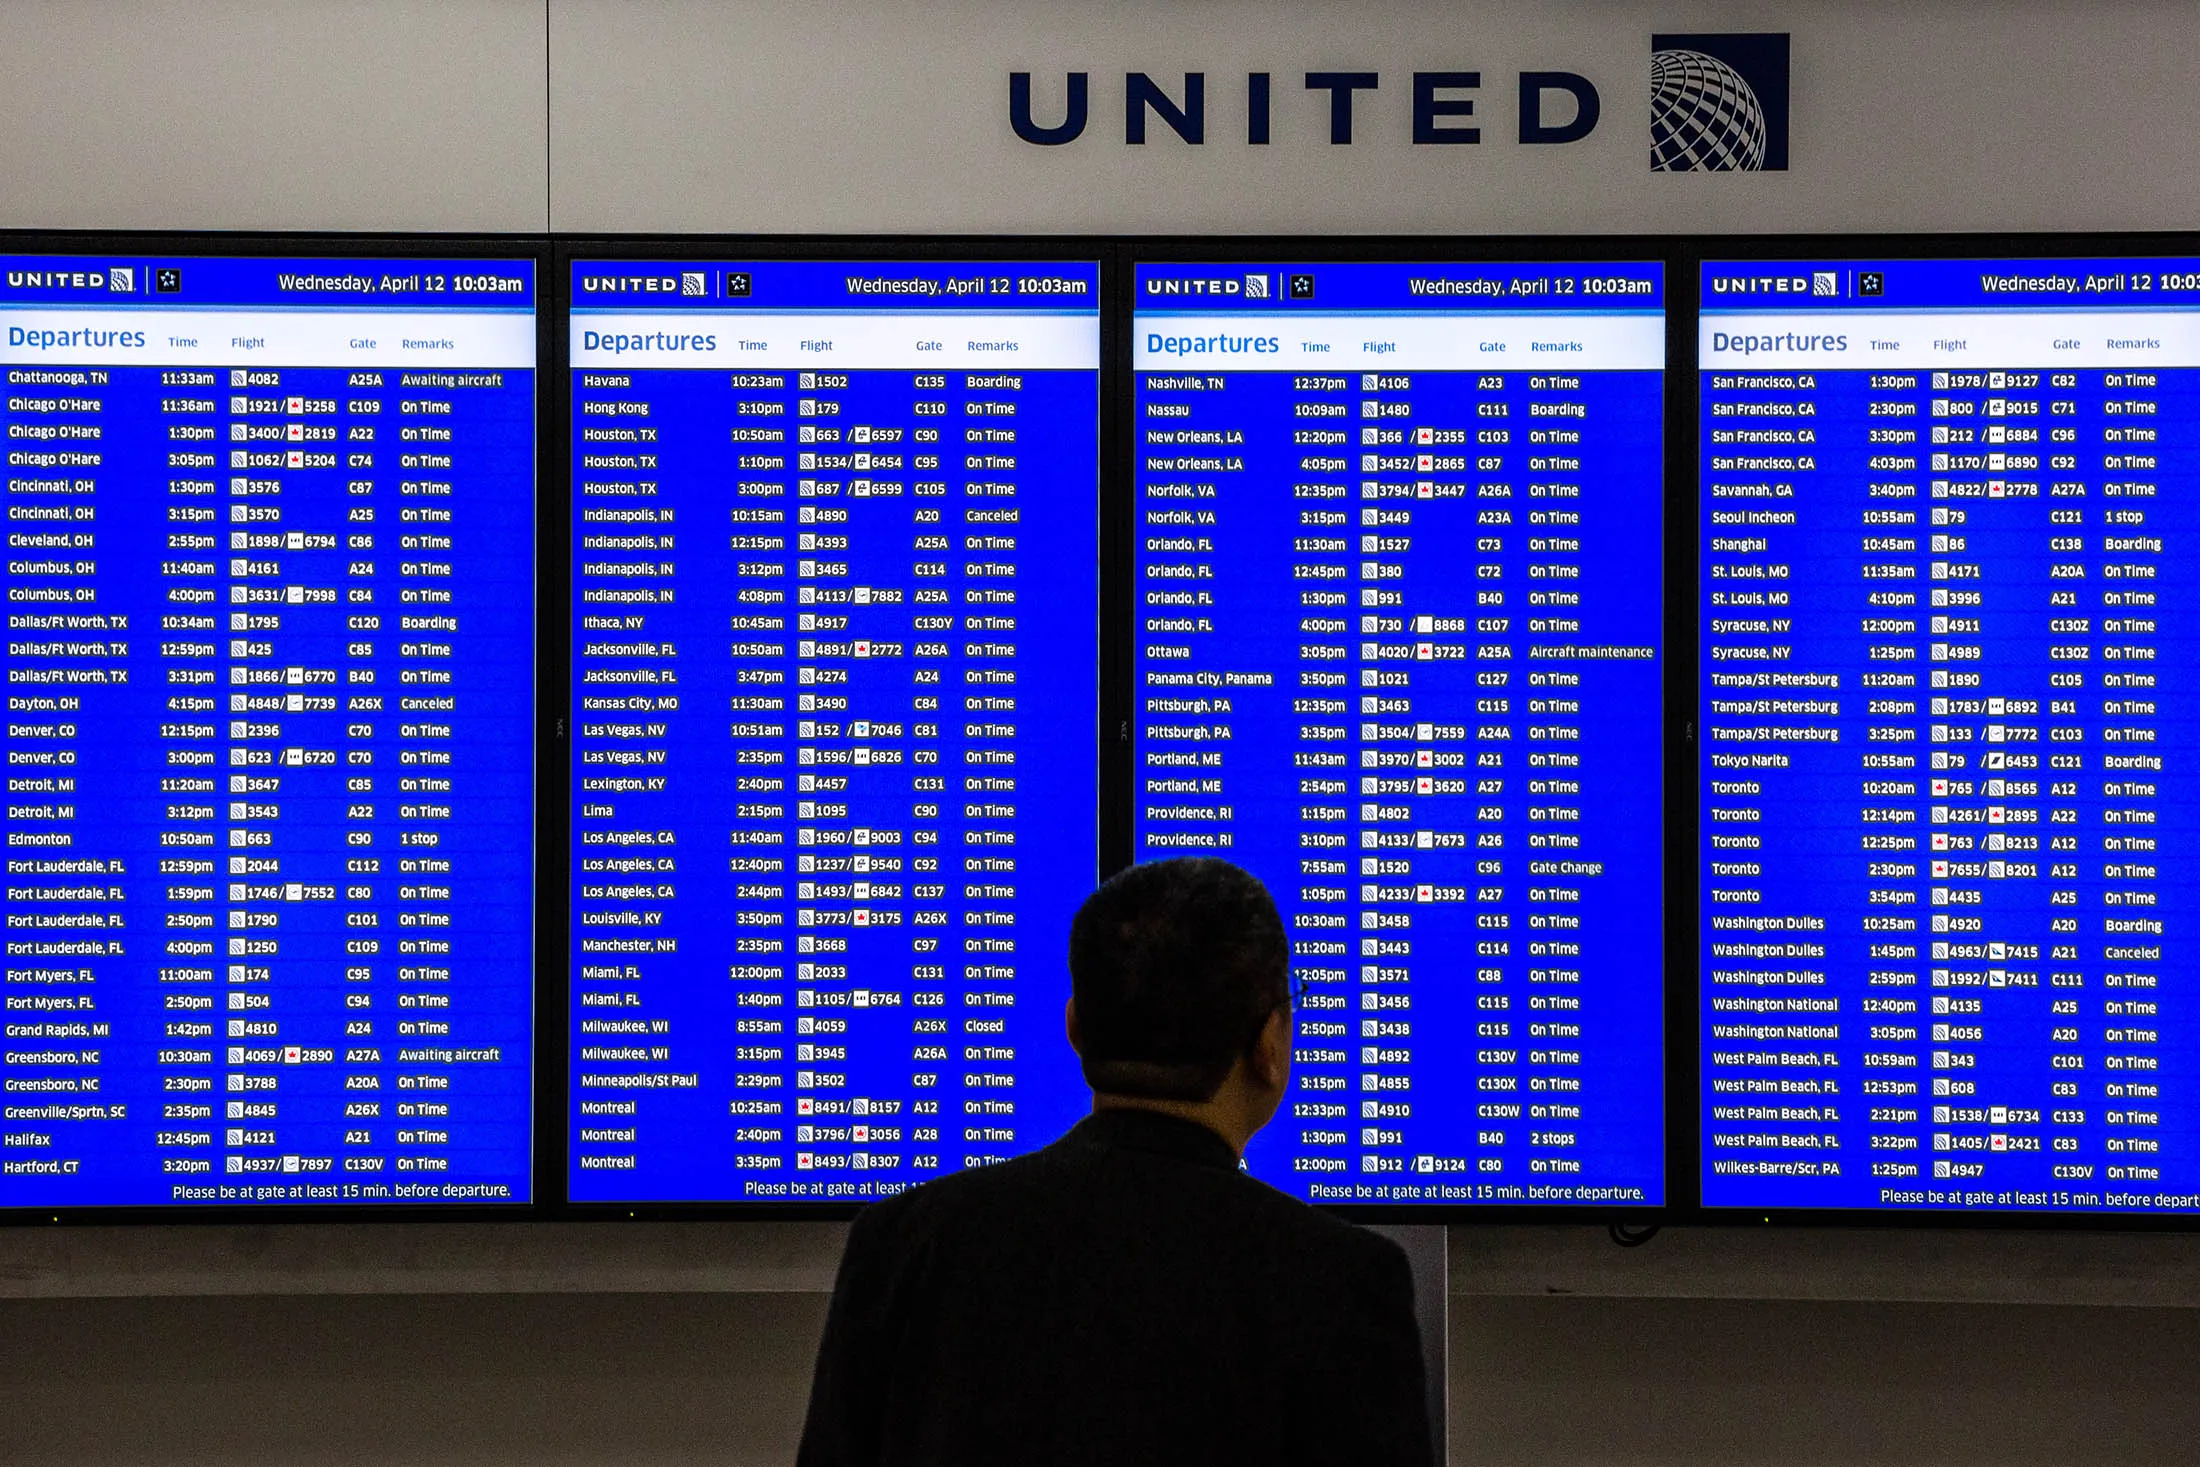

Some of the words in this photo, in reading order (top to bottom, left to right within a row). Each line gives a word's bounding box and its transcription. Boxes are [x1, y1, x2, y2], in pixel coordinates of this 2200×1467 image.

[1009, 71, 1601, 145] UNITED
[8, 272, 104, 287] UNITED
[278, 274, 376, 293] Wednesday,
[380, 275, 419, 293] April
[425, 275, 445, 292] 12
[453, 275, 523, 292] 10:03am
[583, 277, 677, 292] UNITED
[846, 277, 942, 296] Wednesday,
[946, 277, 984, 296] April
[990, 278, 1010, 293] 12
[1018, 278, 1087, 293] 10:03am
[1147, 280, 1240, 294] UNITED
[1410, 278, 1506, 297] Wednesday,
[1510, 278, 1548, 296] April
[1554, 278, 1574, 294] 12
[1583, 278, 1652, 294] 10:03am
[1713, 278, 1807, 293] UNITED
[1982, 275, 2080, 294] Wednesday,
[2084, 274, 2125, 293] April
[2131, 274, 2151, 290] 12
[9, 326, 146, 351] Departures
[168, 337, 198, 348] Time
[231, 337, 264, 349] Flight
[349, 338, 377, 349] Gate
[402, 339, 454, 349] Remarks
[584, 330, 717, 355] Departures
[738, 339, 768, 351] Time
[800, 339, 833, 353] Flight
[916, 341, 943, 351] Gate
[967, 340, 1019, 352] Remarks
[1147, 333, 1280, 357] Departures
[1713, 332, 1848, 356] Departures
[1870, 340, 1900, 351] Time
[1933, 339, 1967, 352] Flight
[2053, 339, 2081, 349] Gate
[2107, 338, 2160, 349] Remarks
[1301, 341, 1331, 353] Time
[1363, 341, 1396, 355] Flight
[1479, 341, 1506, 353] Gate
[1531, 340, 1583, 352] Remarks
[8, 370, 88, 386] Chattanooga,
[90, 371, 108, 384] TN
[162, 372, 215, 385] 11:33am
[247, 372, 279, 385] 4082
[348, 373, 383, 386] A25A
[401, 373, 456, 388] Awaiting
[457, 373, 502, 387] aircraft
[584, 375, 630, 387] Havana
[732, 375, 784, 388] 10:23am
[816, 375, 848, 388] 1502
[914, 376, 945, 388] C135
[967, 375, 1021, 390] Boarding
[1147, 404, 1190, 417] Nassau
[1295, 404, 1346, 417] 10:09am
[1379, 404, 1410, 417] 1480
[1478, 404, 1508, 416] C111
[1530, 402, 1585, 418] Boarding
[1712, 537, 1766, 553] Shanghai
[1863, 538, 1916, 551] 10:45am
[1948, 537, 1966, 551] 86
[2050, 537, 2082, 551] C138
[2105, 536, 2162, 552] Boarding
[9, 615, 65, 629] Dallas/Ft
[66, 615, 108, 630] Worth,
[110, 616, 128, 628] TX
[162, 615, 215, 629] 10:34am
[248, 616, 279, 629] 1795
[348, 616, 380, 629] C120
[401, 615, 457, 631] Boarding
[584, 616, 623, 630] Ithaca,
[625, 616, 644, 629] NY
[732, 617, 784, 629] 10:45am
[815, 617, 848, 629] 4917
[914, 617, 953, 629] C130Y
[966, 617, 983, 629] On
[984, 616, 1015, 629] Time
[1147, 672, 1194, 685] Panama
[1196, 671, 1223, 687] City,
[1225, 672, 1273, 685] Panama
[1301, 672, 1346, 687] 3:50pm
[1378, 672, 1409, 685] 1021
[1477, 672, 1508, 685] C127
[1529, 673, 1546, 686] On
[1548, 672, 1579, 686] Time
[8, 832, 71, 846] Edmonton
[161, 832, 214, 845] 10:50am
[247, 832, 272, 845] 663
[347, 832, 372, 845] C90
[401, 832, 409, 845] 1
[411, 832, 438, 847] stop
[1301, 861, 1346, 873] 7:55am
[1378, 861, 1410, 874] 1520
[1477, 861, 1501, 874] C96
[1530, 861, 1558, 874] Gate
[1560, 861, 1602, 876] Change
[1712, 916, 1784, 931] Washington
[1786, 916, 1825, 930] Dulles
[1863, 917, 1916, 930] 10:25am
[1948, 918, 1982, 931] 4920
[2051, 919, 2077, 932] A20
[2105, 918, 2163, 934] Boarding
[582, 1019, 649, 1034] Milwaukee,
[651, 1020, 669, 1033] WI
[737, 1020, 782, 1033] 8:55am
[814, 1020, 846, 1033] 4059
[914, 1020, 946, 1032] A26X
[965, 1019, 1004, 1033] Closed
[1302, 1131, 1346, 1145] 1:30pm
[1379, 1131, 1403, 1144] 991
[1479, 1132, 1504, 1145] B40
[1531, 1132, 1540, 1145] 2
[1542, 1132, 1575, 1147] stops
[1714, 1160, 1820, 1176] Wilkes-Barre/Scr,
[1822, 1162, 1840, 1175] PA
[1872, 1163, 1918, 1177] 1:25pm
[1951, 1164, 1984, 1177] 4947
[2053, 1165, 2093, 1178] C130V
[2107, 1166, 2125, 1179] On
[2126, 1166, 2159, 1179] Time
[173, 1185, 216, 1199] Please
[219, 1185, 237, 1199] be
[239, 1185, 253, 1199] at
[256, 1185, 286, 1200] gate
[289, 1185, 303, 1198] at
[306, 1184, 338, 1198] least
[342, 1184, 359, 1198] 15
[363, 1183, 392, 1197] min.
[395, 1183, 439, 1197] before
[442, 1183, 511, 1199] departure.
[745, 1181, 787, 1195] Please
[791, 1181, 807, 1195] be
[810, 1182, 824, 1195] at
[827, 1182, 855, 1197] gate
[858, 1182, 872, 1195] at
[876, 1181, 906, 1195] least
[1310, 1183, 1353, 1198] Please
[1356, 1184, 1373, 1198] be
[1375, 1185, 1389, 1198] at
[1392, 1185, 1421, 1200] gate
[1424, 1185, 1438, 1198] at
[1441, 1184, 1473, 1199] least
[1477, 1185, 1493, 1199] 15
[1497, 1185, 1525, 1199] min.
[1529, 1185, 1573, 1199] before
[1575, 1185, 1644, 1201] departure.
[1881, 1189, 1924, 1203] Please
[1928, 1189, 1945, 1203] be
[1948, 1191, 1962, 1204] at
[1965, 1191, 1994, 1206] gate
[1998, 1191, 2012, 1205] at
[2015, 1191, 2048, 1205] least
[2052, 1192, 2069, 1205] 15
[2073, 1191, 2102, 1206] min.
[2106, 1192, 2151, 1207] before
